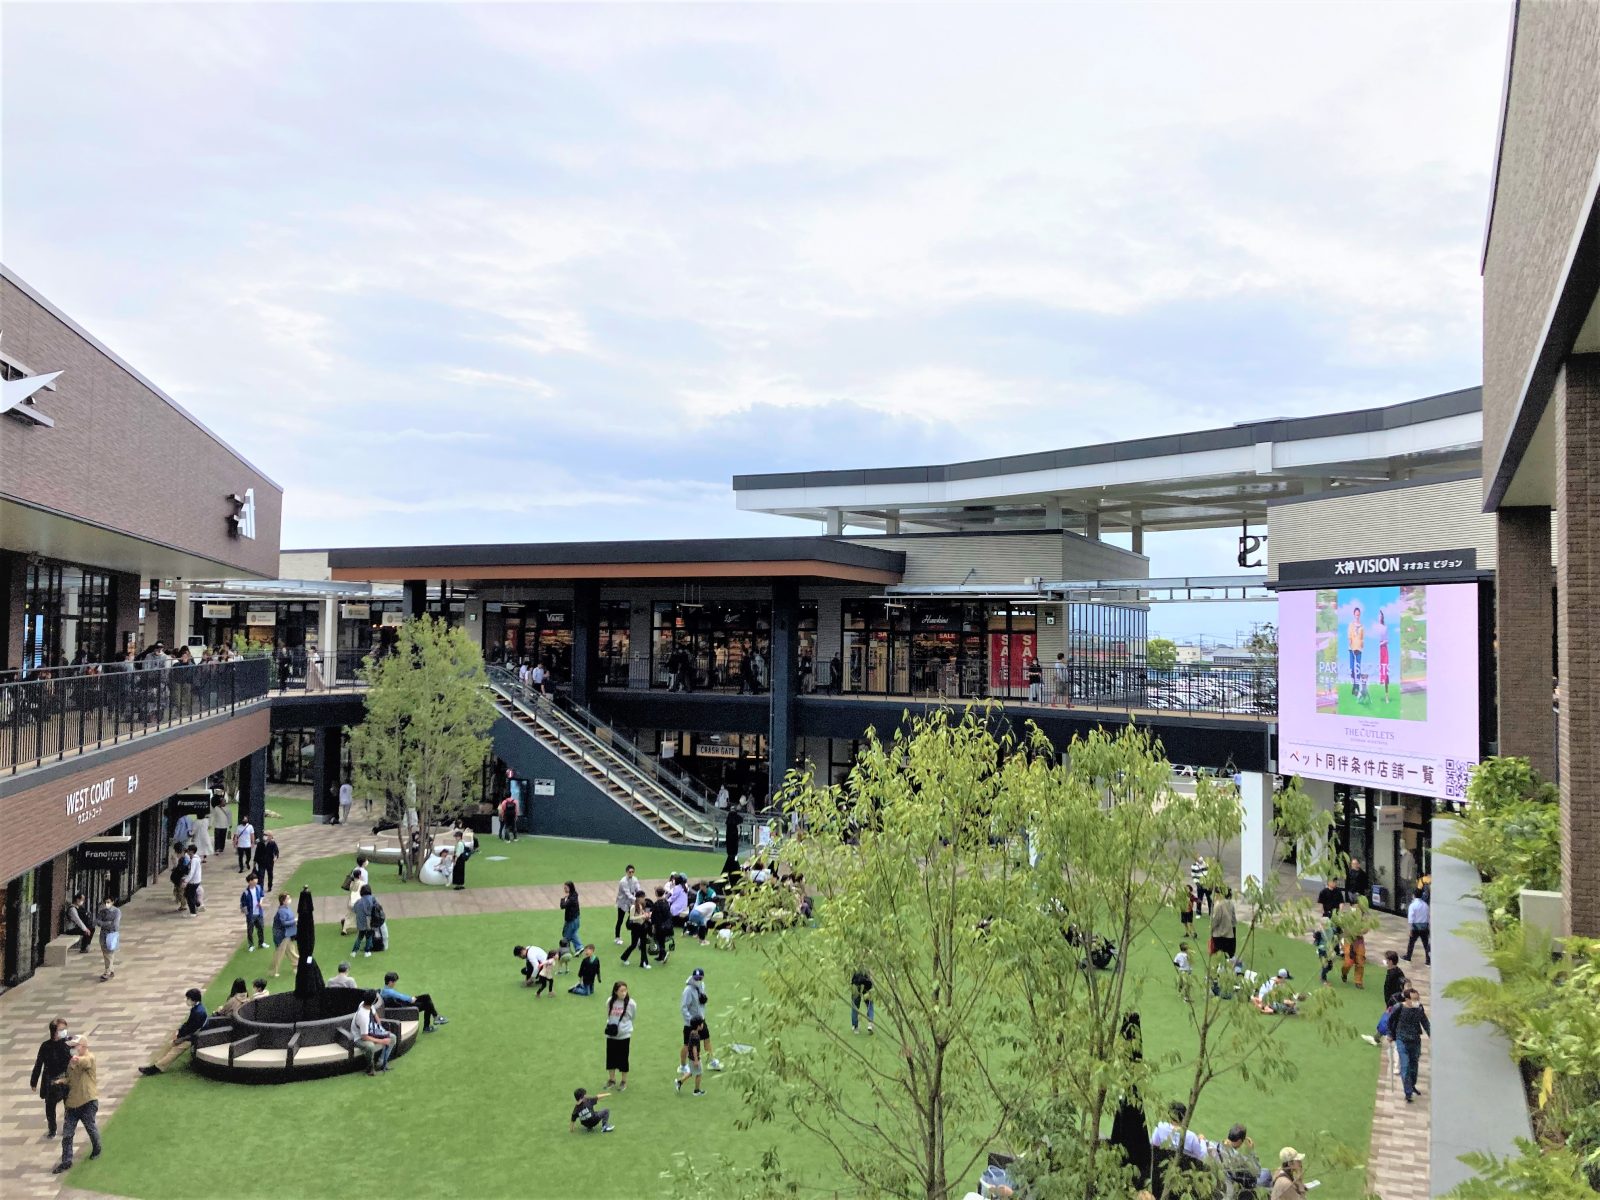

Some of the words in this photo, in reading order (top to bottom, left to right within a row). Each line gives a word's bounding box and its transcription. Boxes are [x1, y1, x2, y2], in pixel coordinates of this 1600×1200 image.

[1402, 560, 1431, 570] オオカミ
[1433, 559, 1463, 569] ビジョン
[546, 613, 565, 622] VANS
[921, 614, 949, 624] Hawkins
[1022, 634, 1032, 681] SALE
[720, 747, 736, 756] GATE
[1289, 750, 1435, 785] ペット同伴条件店舗一覧
[66, 787, 89, 816] WEST
[90, 777, 115, 805] COURT
